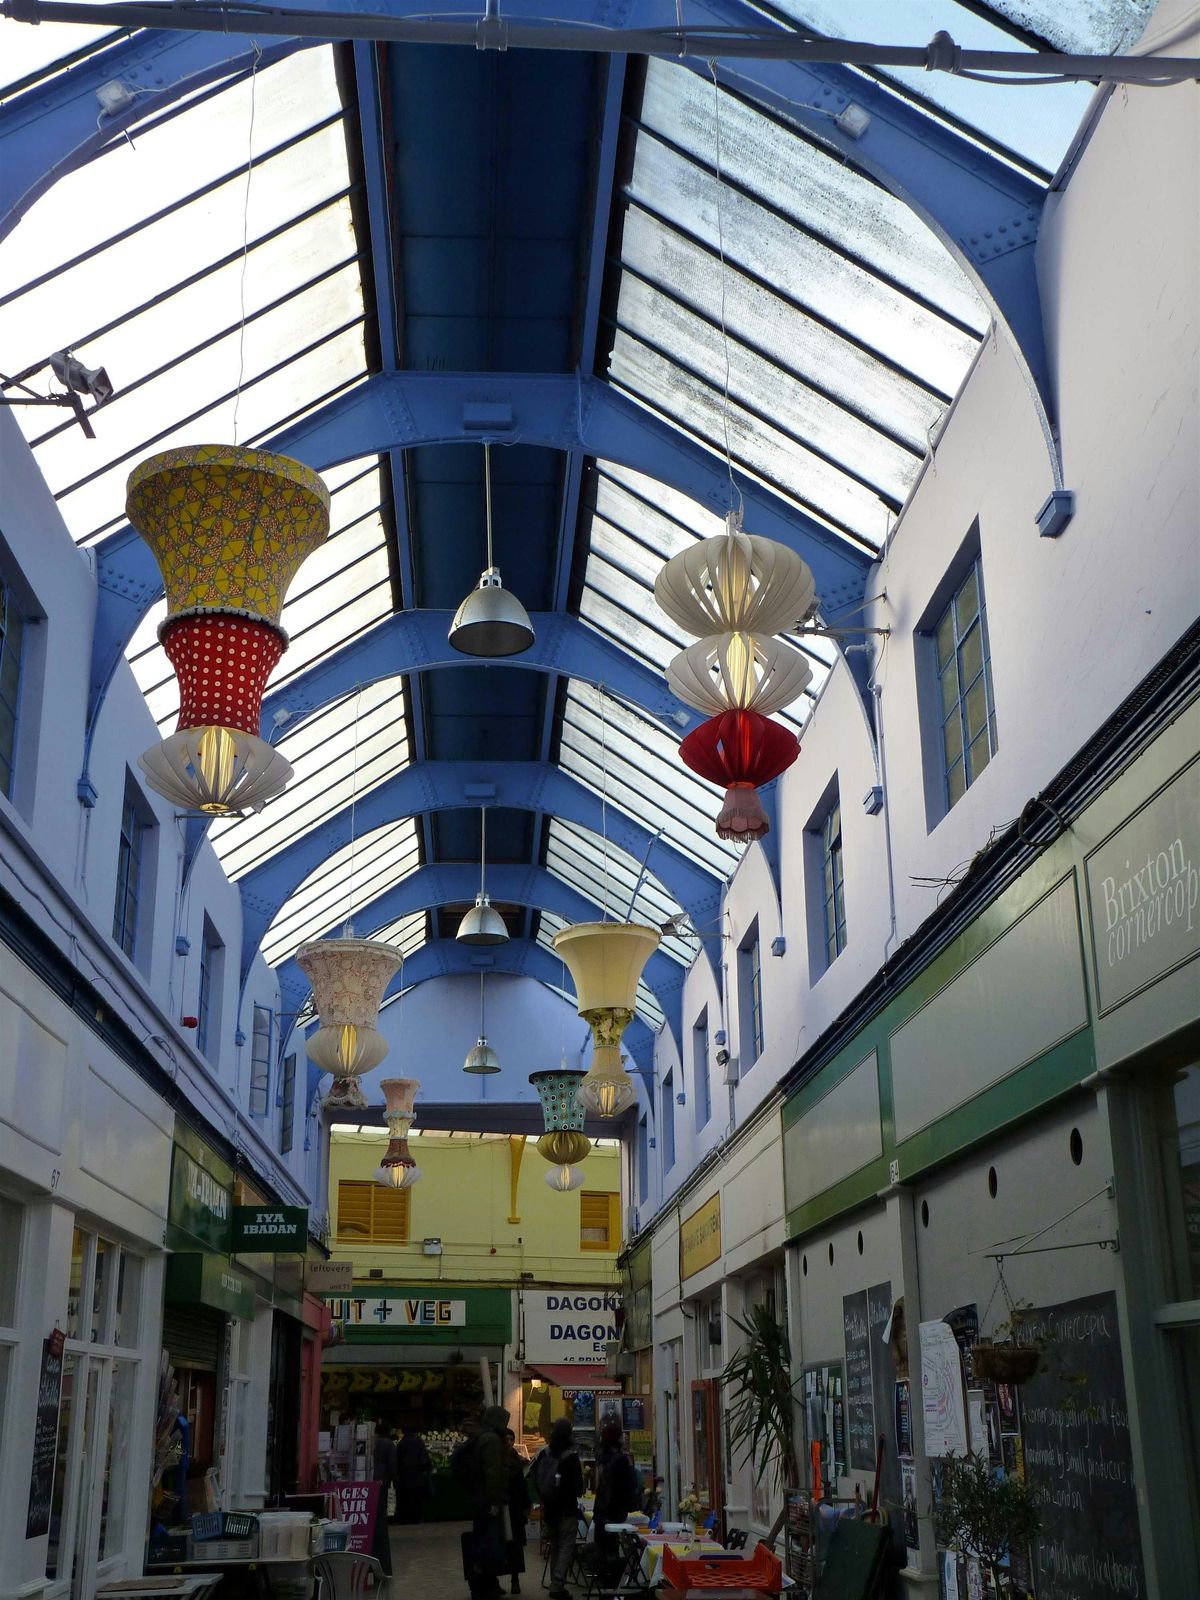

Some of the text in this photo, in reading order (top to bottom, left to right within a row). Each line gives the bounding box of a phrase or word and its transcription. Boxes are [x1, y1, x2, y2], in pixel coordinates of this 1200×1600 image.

[1101, 838, 1188, 932] Brixton
[1108, 859, 1200, 968] cornercop
[50, 1168, 61, 1190] 67
[256, 1213, 285, 1223] IYA
[243, 1224, 297, 1235] IBADAN
[310, 1264, 351, 1273] leftovers
[325, 1299, 367, 1324] UIT
[405, 1300, 451, 1324] VEG
[550, 1324, 621, 1341] DAGON
